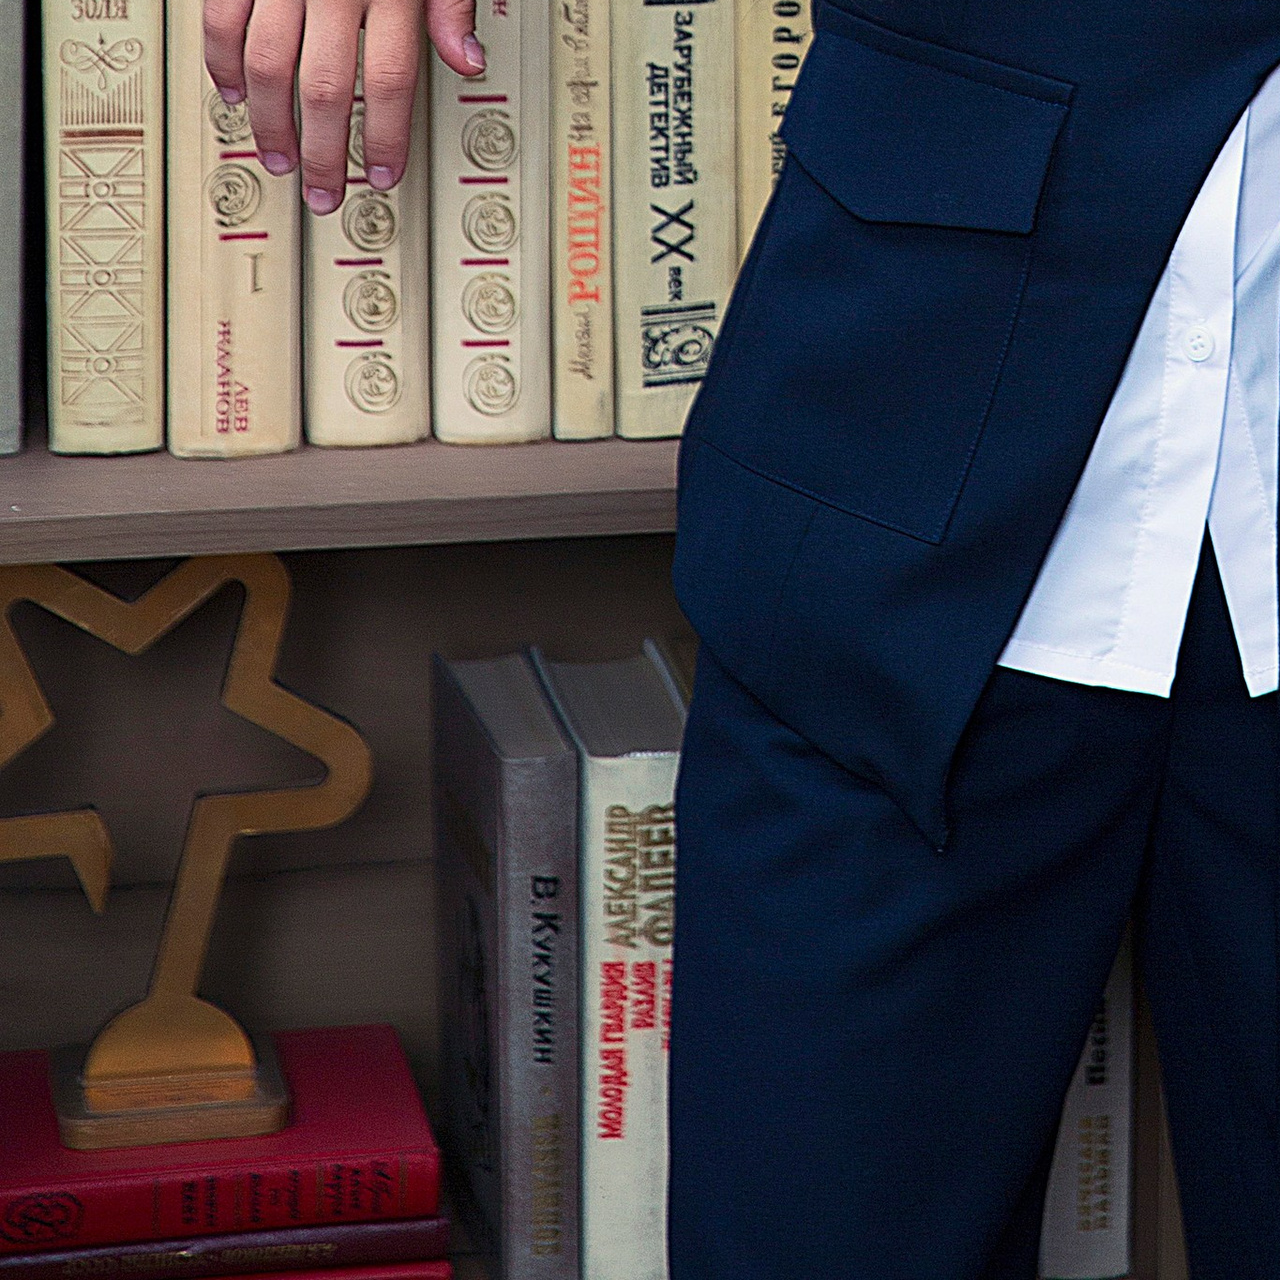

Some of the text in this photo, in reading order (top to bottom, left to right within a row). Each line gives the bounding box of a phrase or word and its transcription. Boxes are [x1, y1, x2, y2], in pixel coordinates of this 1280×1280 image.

[646, 61, 672, 189] ДЕТЕКТИВ
[673, 10, 698, 185] ЗАРУБЕЖНЫЙ
[566, 141, 603, 305] РОЩИН
[233, 380, 250, 434] ЛЕВ
